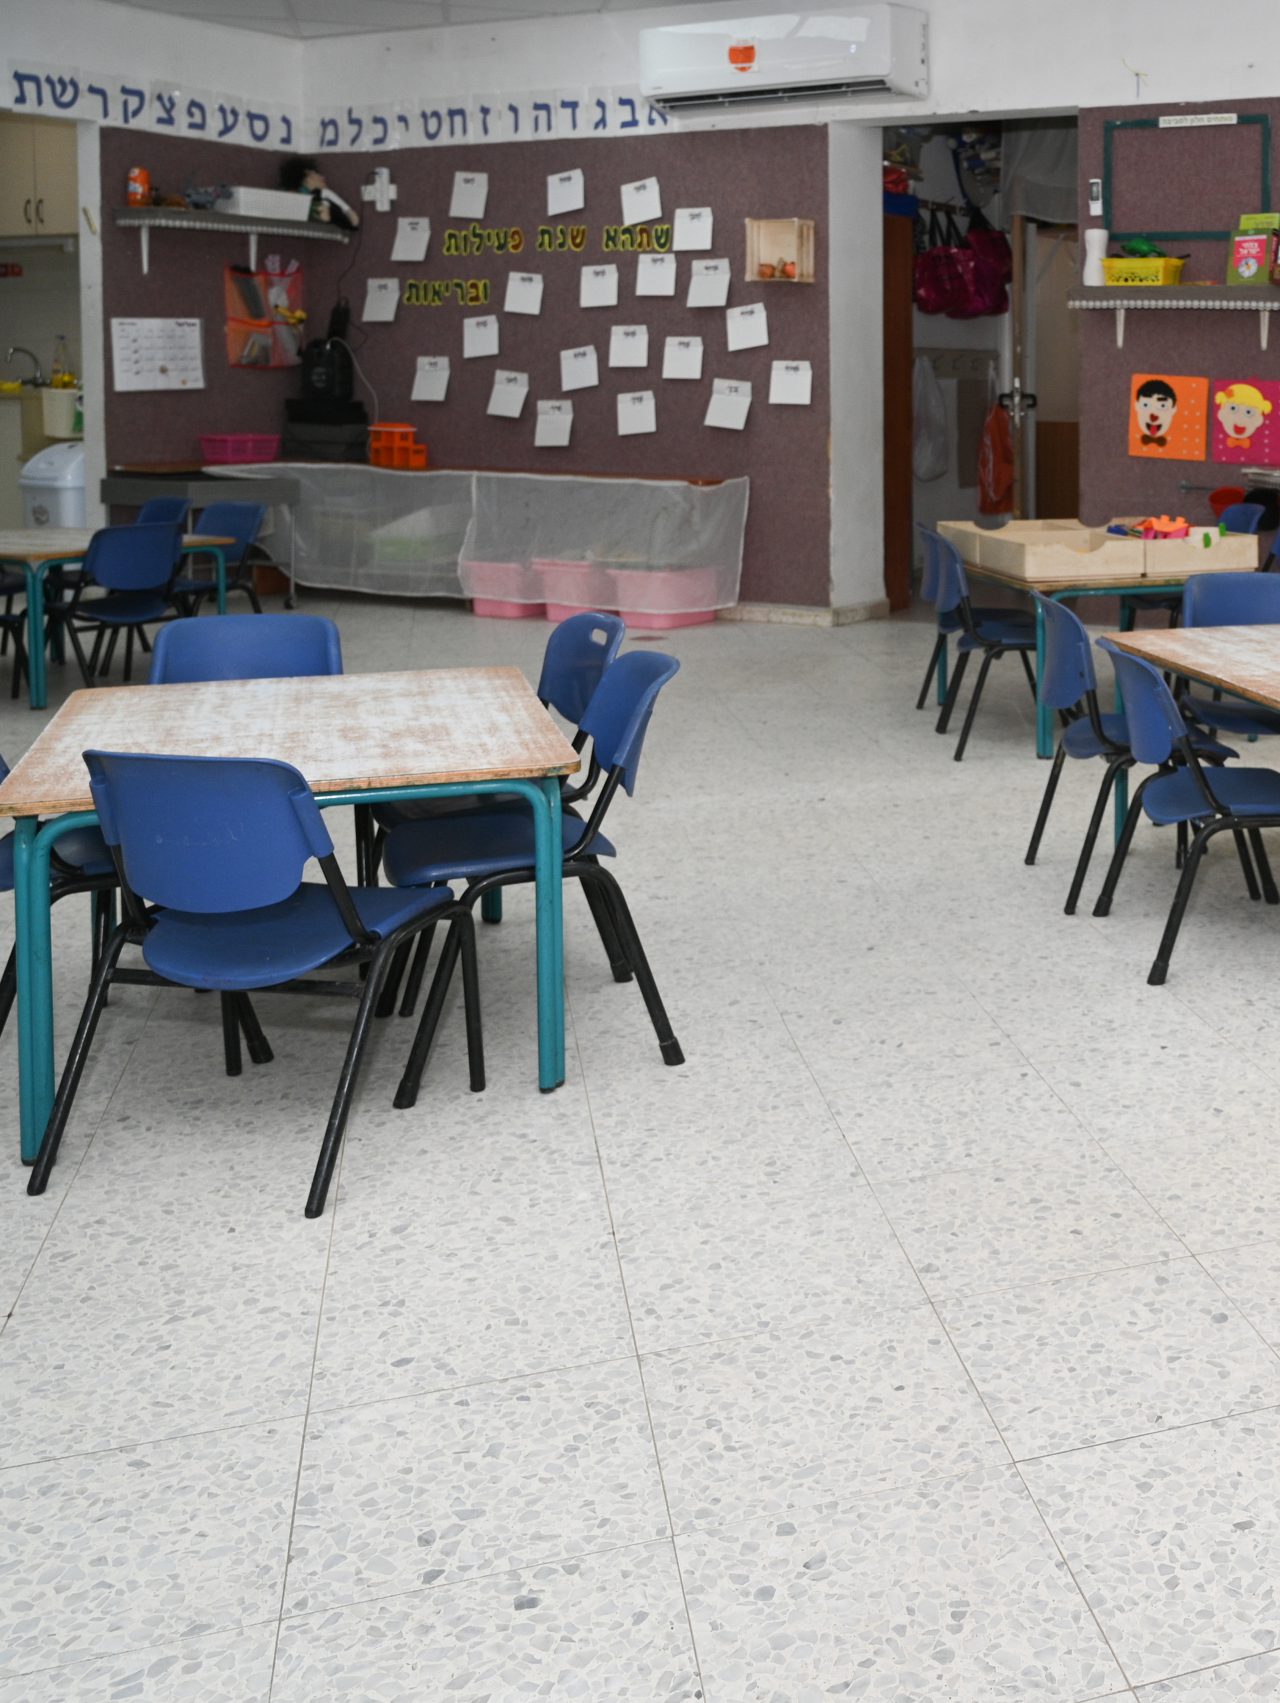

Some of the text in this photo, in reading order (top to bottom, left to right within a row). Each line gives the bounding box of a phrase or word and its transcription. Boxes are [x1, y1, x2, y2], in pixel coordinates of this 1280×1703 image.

[443, 223, 672, 256] שתהא שנת פעילות
[403, 279, 490, 306] ובריאות
